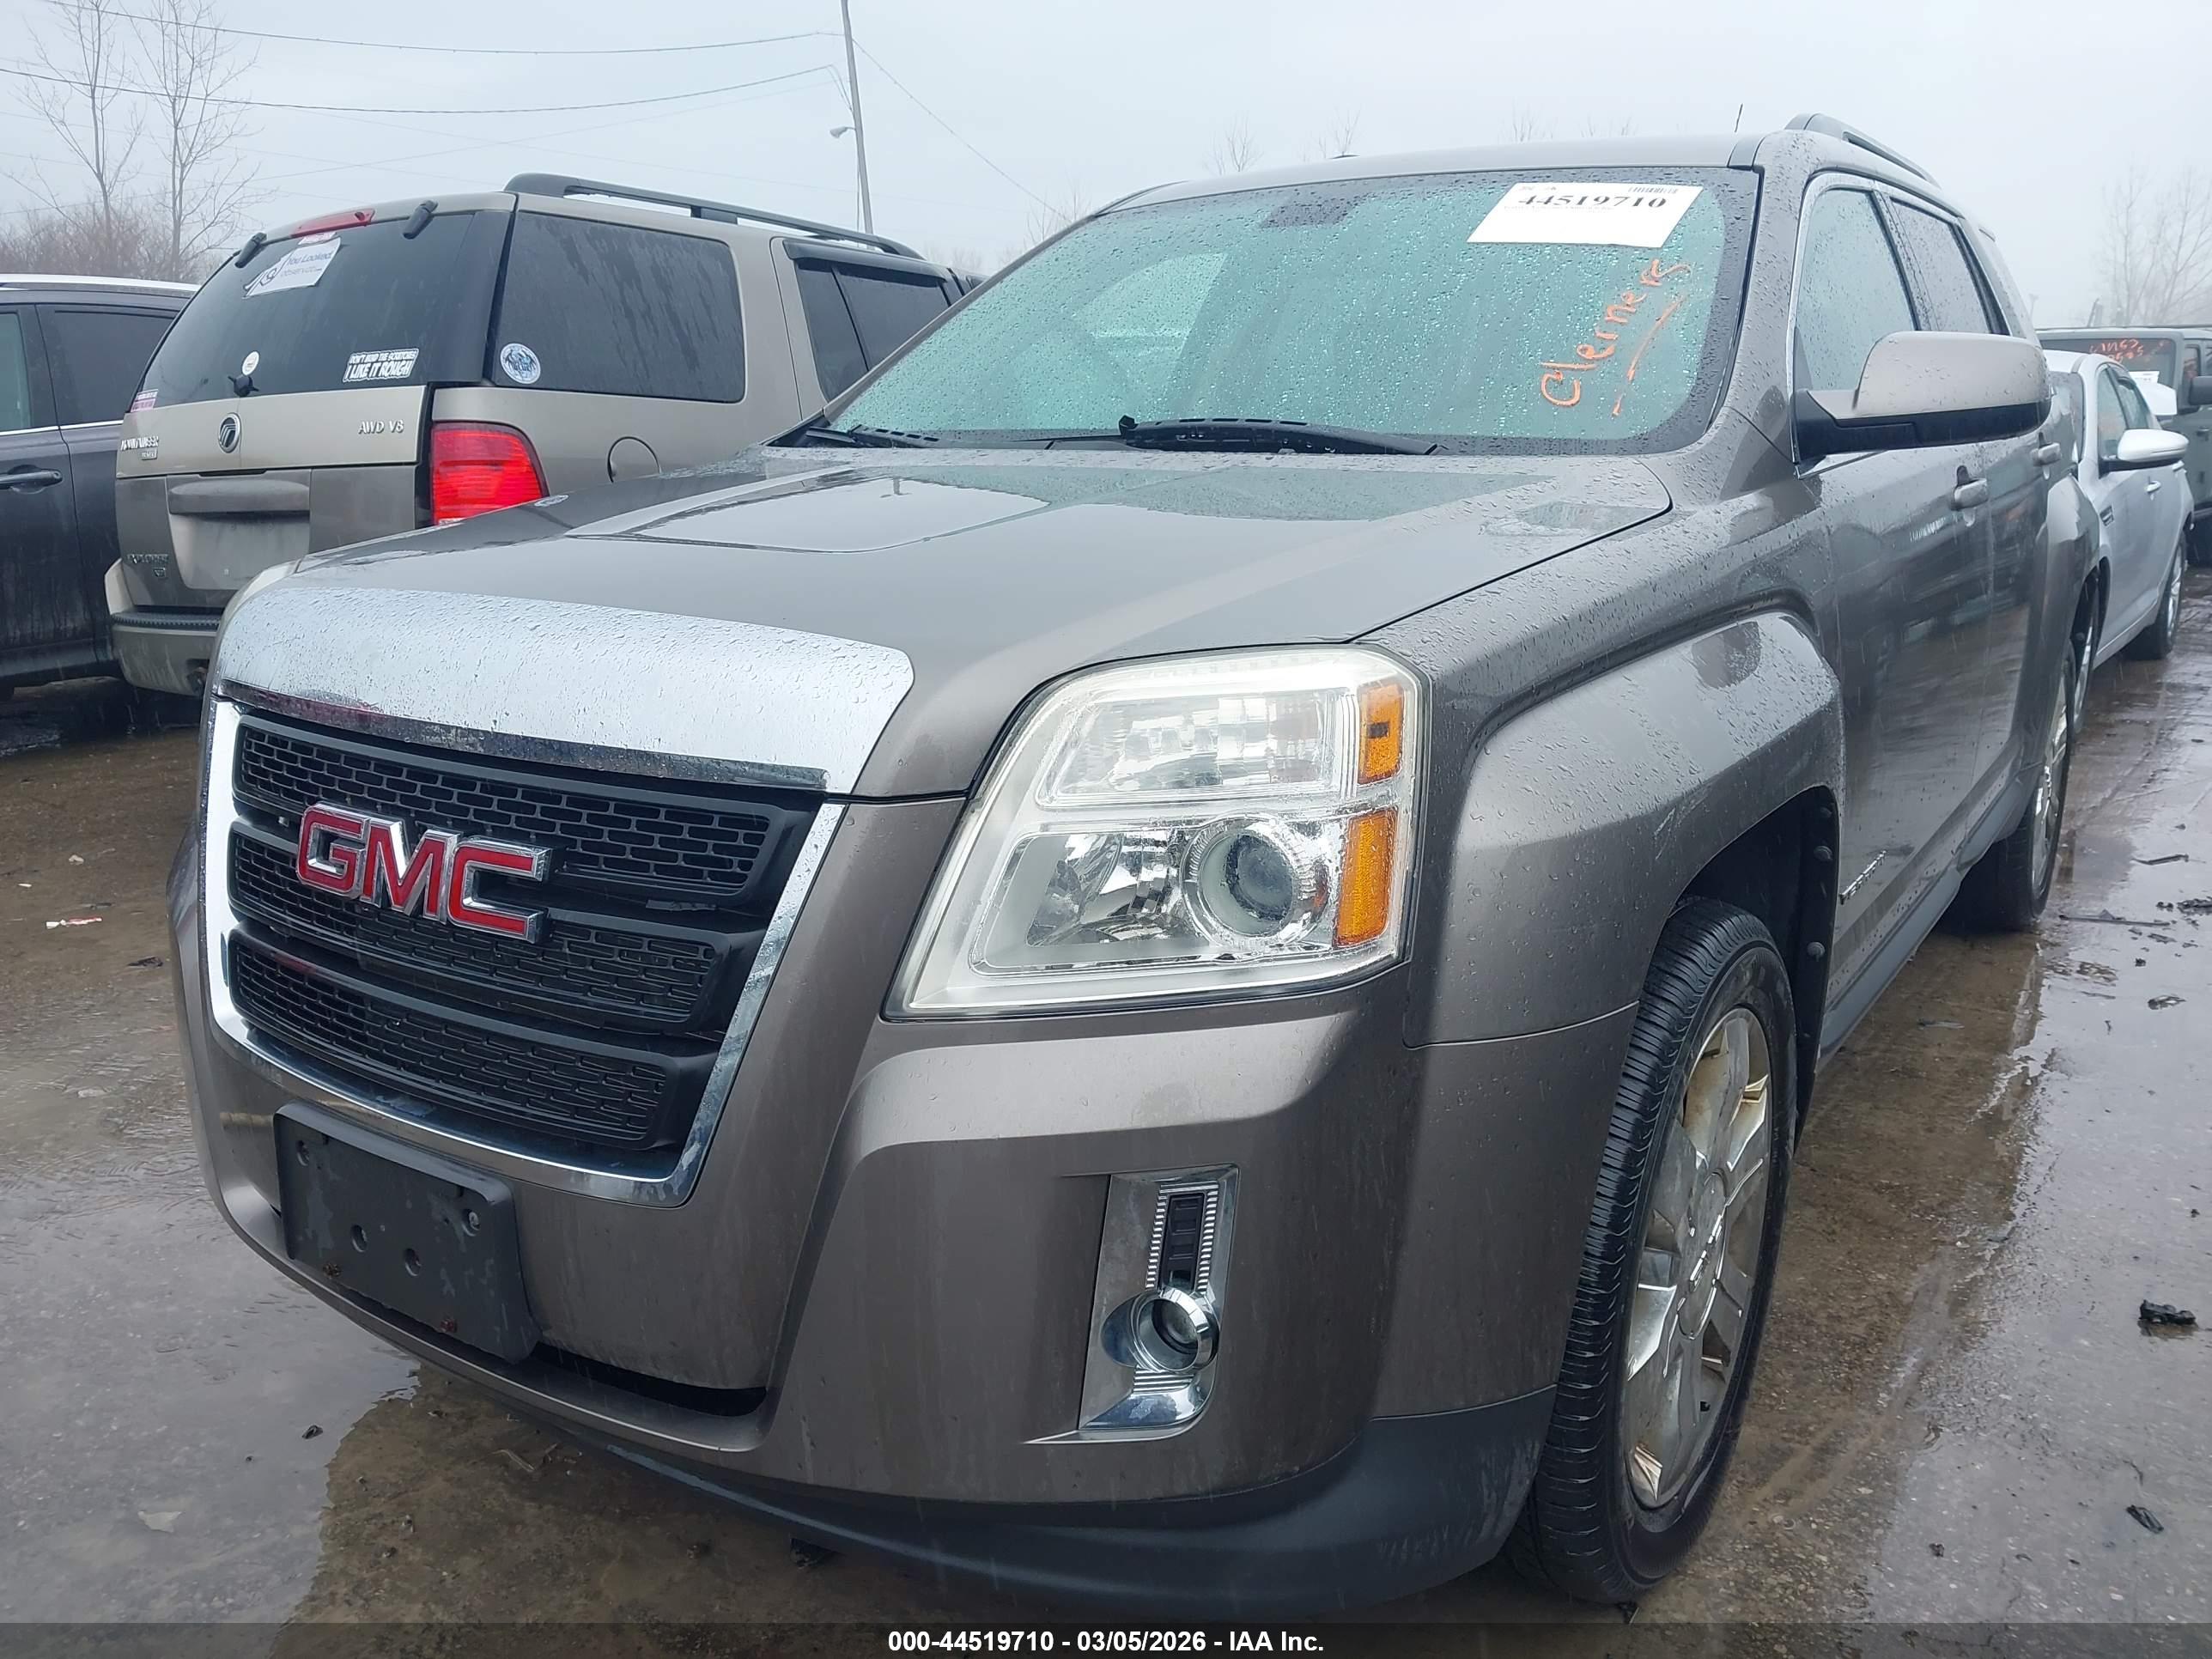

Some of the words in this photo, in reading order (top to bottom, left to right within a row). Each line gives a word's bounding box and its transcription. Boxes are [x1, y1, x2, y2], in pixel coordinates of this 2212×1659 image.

[1518, 194, 1667, 209] 44519710
[349, 362, 371, 379] LIKE
[368, 362, 381, 378] IT
[378, 360, 413, 377] ROUGH
[358, 420, 385, 434] AWD
[389, 420, 404, 434] V8
[296, 801, 551, 944] GMC
